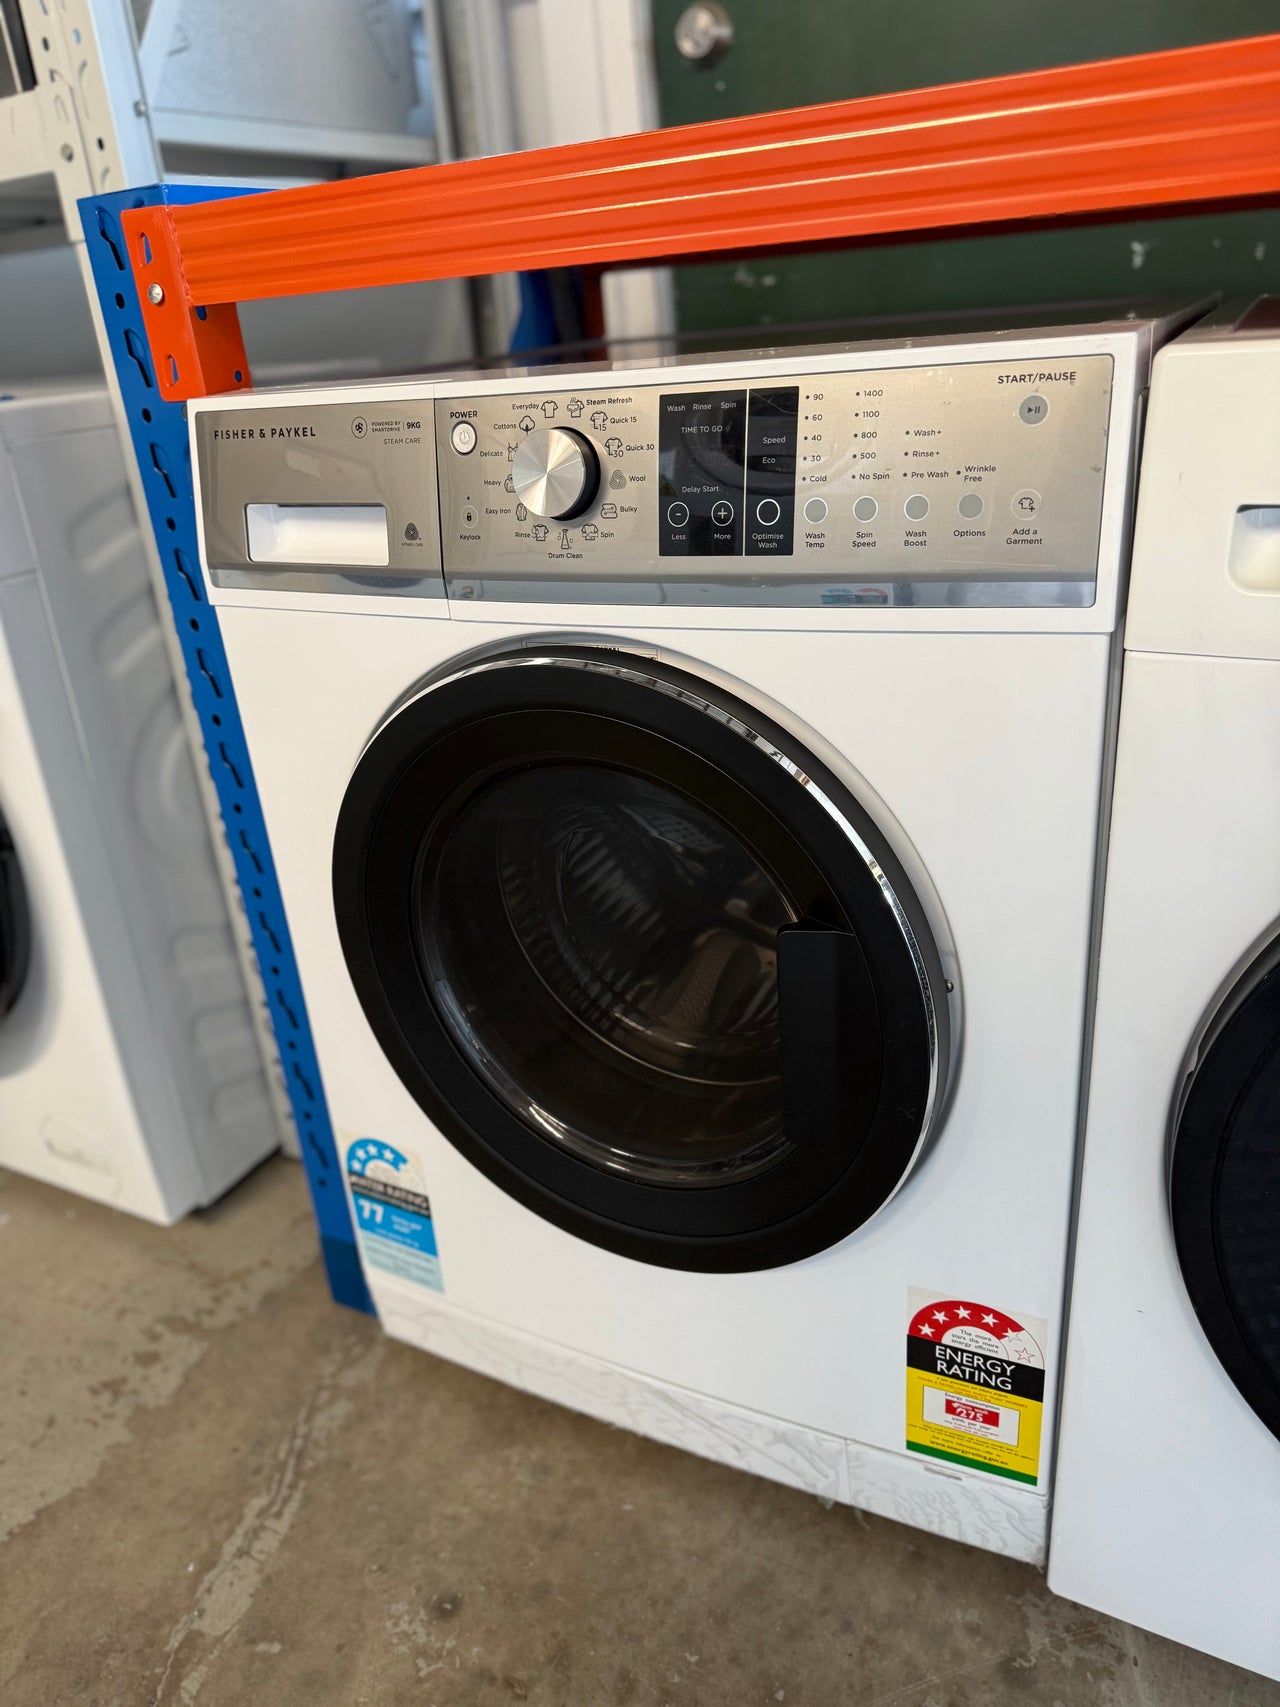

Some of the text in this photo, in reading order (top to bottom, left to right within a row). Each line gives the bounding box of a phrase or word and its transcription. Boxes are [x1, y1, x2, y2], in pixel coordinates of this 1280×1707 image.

[997, 371, 1077, 384] START/PAUSE
[863, 389, 883, 397] 1400
[692, 403, 712, 411] Rinse
[720, 401, 737, 409] Spin
[450, 410, 478, 419] POWER
[406, 421, 421, 429] 9KG
[599, 424, 607, 432] 15
[214, 427, 316, 440] FISHER & PAYKEL
[681, 426, 698, 434] TIME
[711, 425, 723, 433] GO
[861, 431, 878, 439] 800
[762, 436, 786, 444] Speed
[613, 450, 624, 458] 30
[872, 472, 890, 480] Spin
[682, 486, 701, 494] Delay
[752, 533, 784, 541] Optimise
[953, 529, 986, 537] Options
[805, 541, 825, 549] Temp
[852, 540, 876, 548] Speed
[1006, 537, 1043, 545] Garment
[952, 1333, 966, 1341] stars
[951, 1339, 971, 1348] energy
[935, 1345, 1016, 1376] ENERGY
[937, 1359, 1012, 1390] RATING
[945, 1392, 963, 1401] Energy
[957, 1408, 984, 1422] 275
